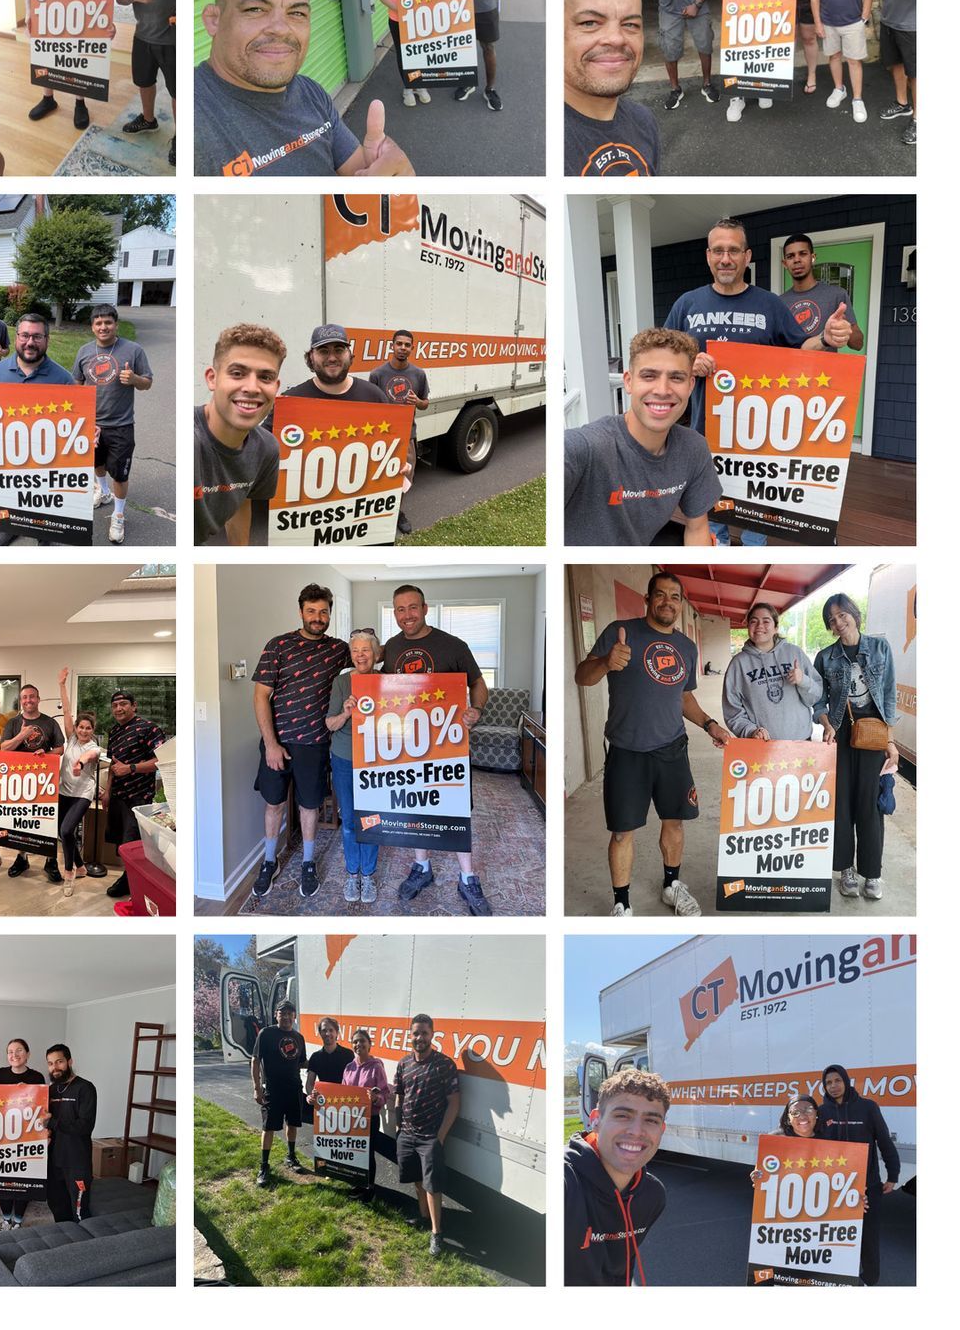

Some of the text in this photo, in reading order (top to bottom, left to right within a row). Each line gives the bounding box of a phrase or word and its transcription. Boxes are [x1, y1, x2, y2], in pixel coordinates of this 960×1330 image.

[405, 34, 472, 56] Stress-Free
[426, 51, 458, 66] Move
[595, 150, 616, 169] EST.
[420, 249, 465, 272] EST. 1972
[686, 312, 767, 330] YANKEES
[415, 338, 467, 360] KEEPS
[471, 338, 497, 357] YOU
[500, 338, 539, 357] MOVING,
[713, 395, 846, 451] 100%
[713, 455, 840, 482] Stress-Free
[18, 491, 64, 508] Move
[747, 481, 804, 503] Move
[661, 657, 671, 665] CT
[358, 704, 462, 762] 100%
[359, 763, 464, 790] Stress-Free
[390, 789, 440, 809] Move
[728, 772, 829, 827] 100%
[726, 827, 829, 855] Stress-Free
[757, 853, 805, 874] Move
[690, 978, 725, 1020] CT
[740, 1000, 788, 1021] EST. 1972
[451, 1032, 521, 1066] YOU
[671, 1084, 705, 1099] WHEN
[742, 1079, 800, 1097] KEEPS
[761, 1172, 859, 1219] 100%
[757, 1224, 857, 1244] Stress-Free
[785, 1246, 832, 1264] Move
